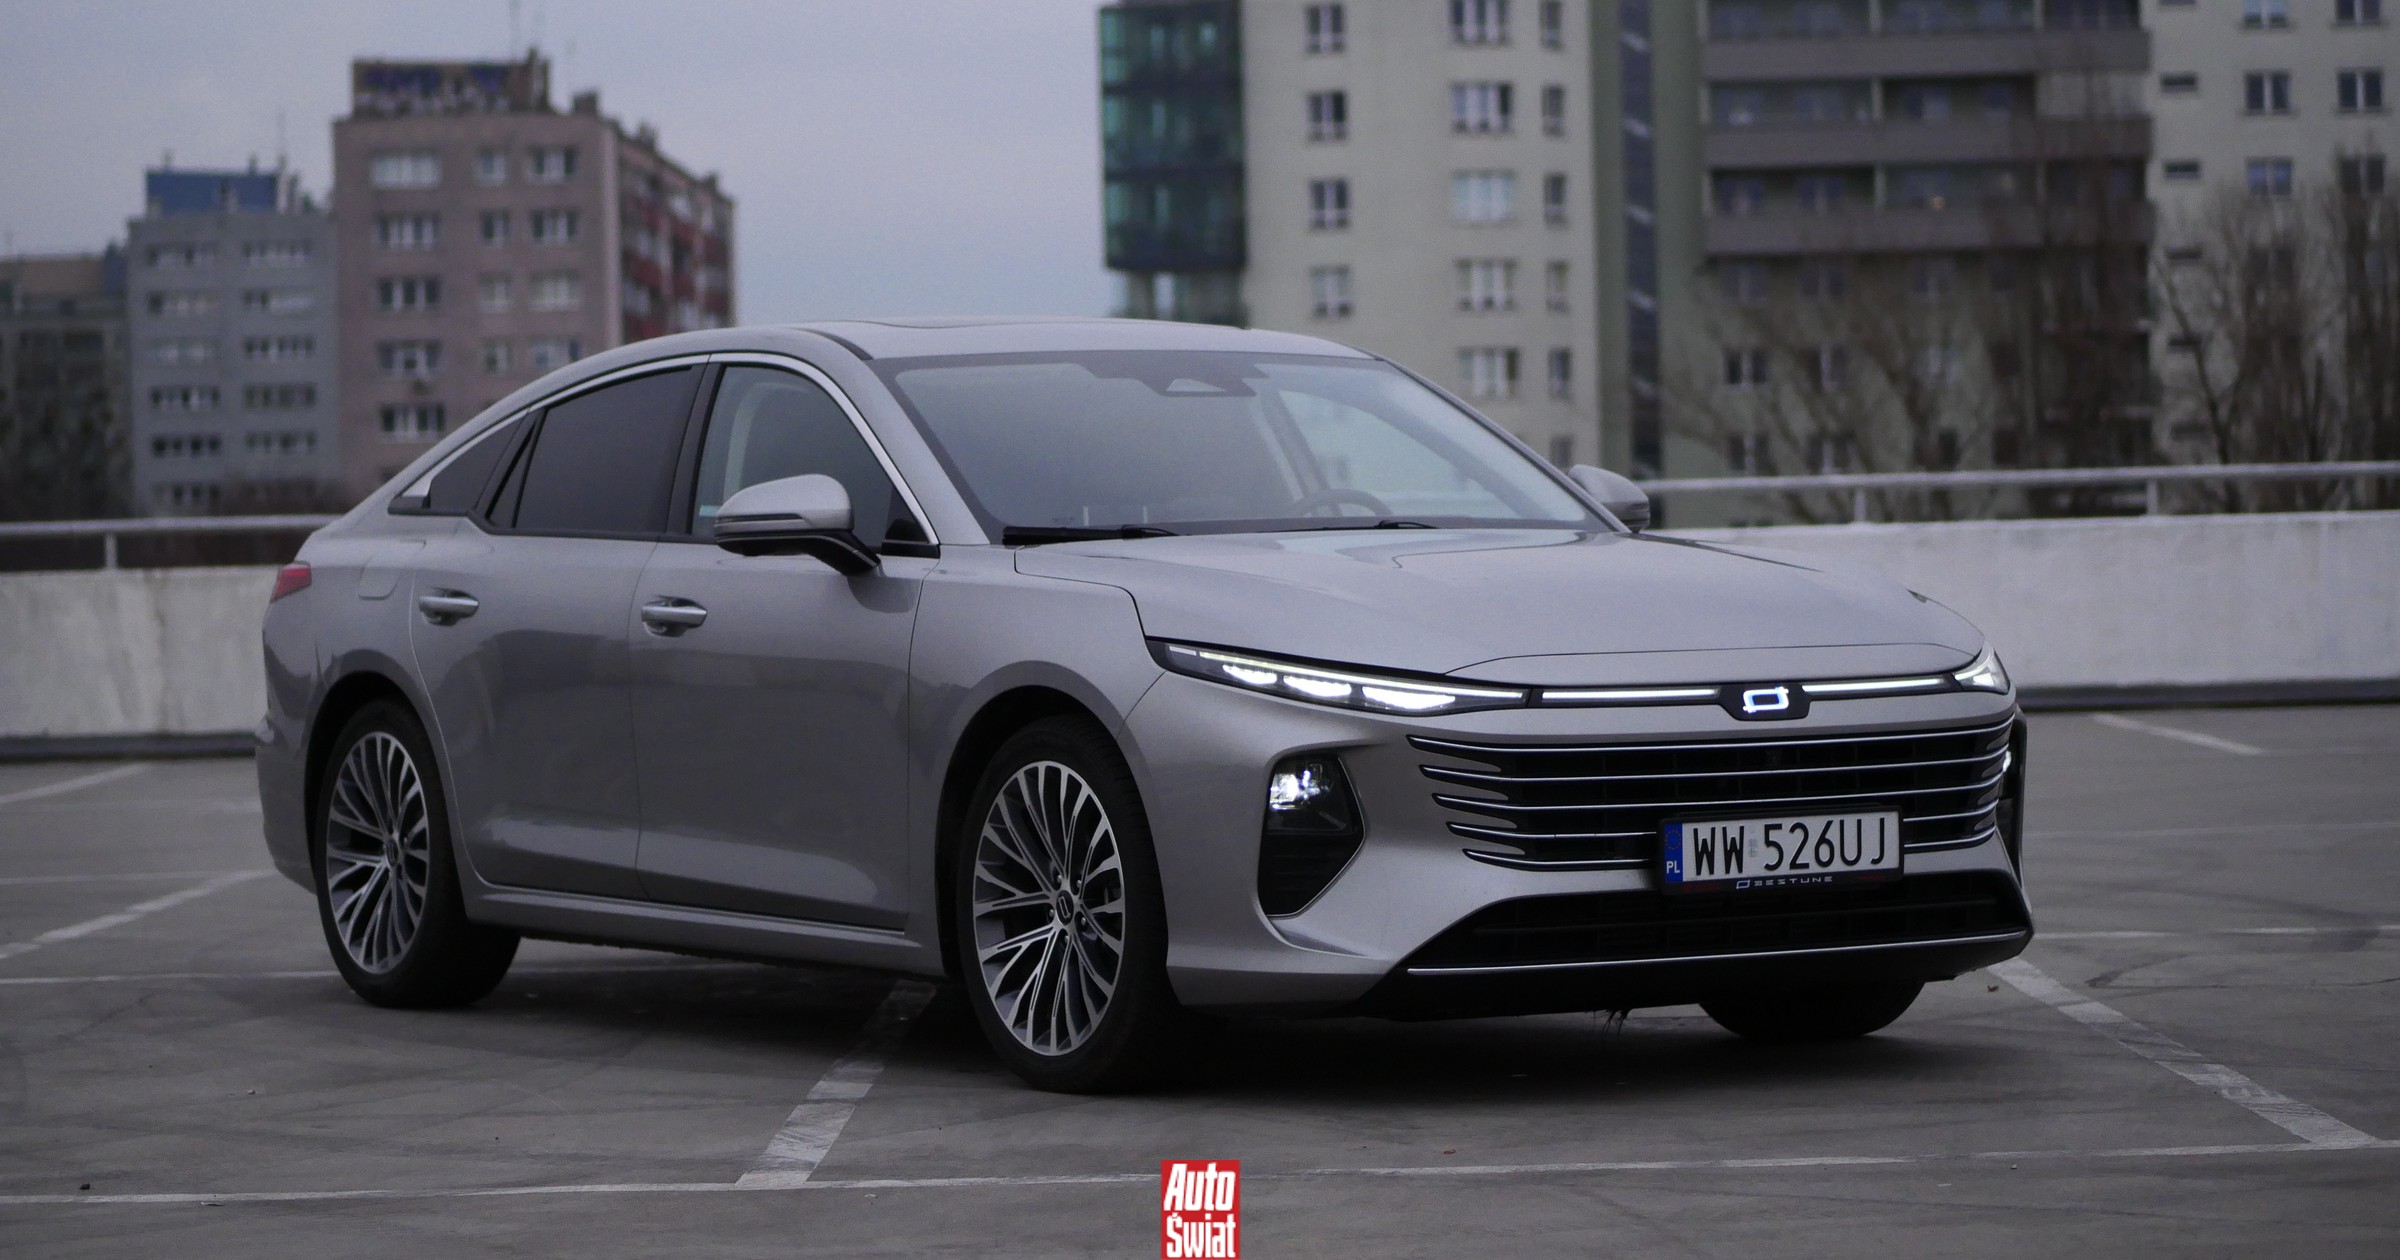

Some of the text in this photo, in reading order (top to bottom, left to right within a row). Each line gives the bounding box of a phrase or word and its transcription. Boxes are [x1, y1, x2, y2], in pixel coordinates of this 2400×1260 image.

[1693, 817, 1885, 876] WW 526UJ
[1666, 860, 1681, 874] PL
[1754, 876, 1833, 887] BESTUNE
